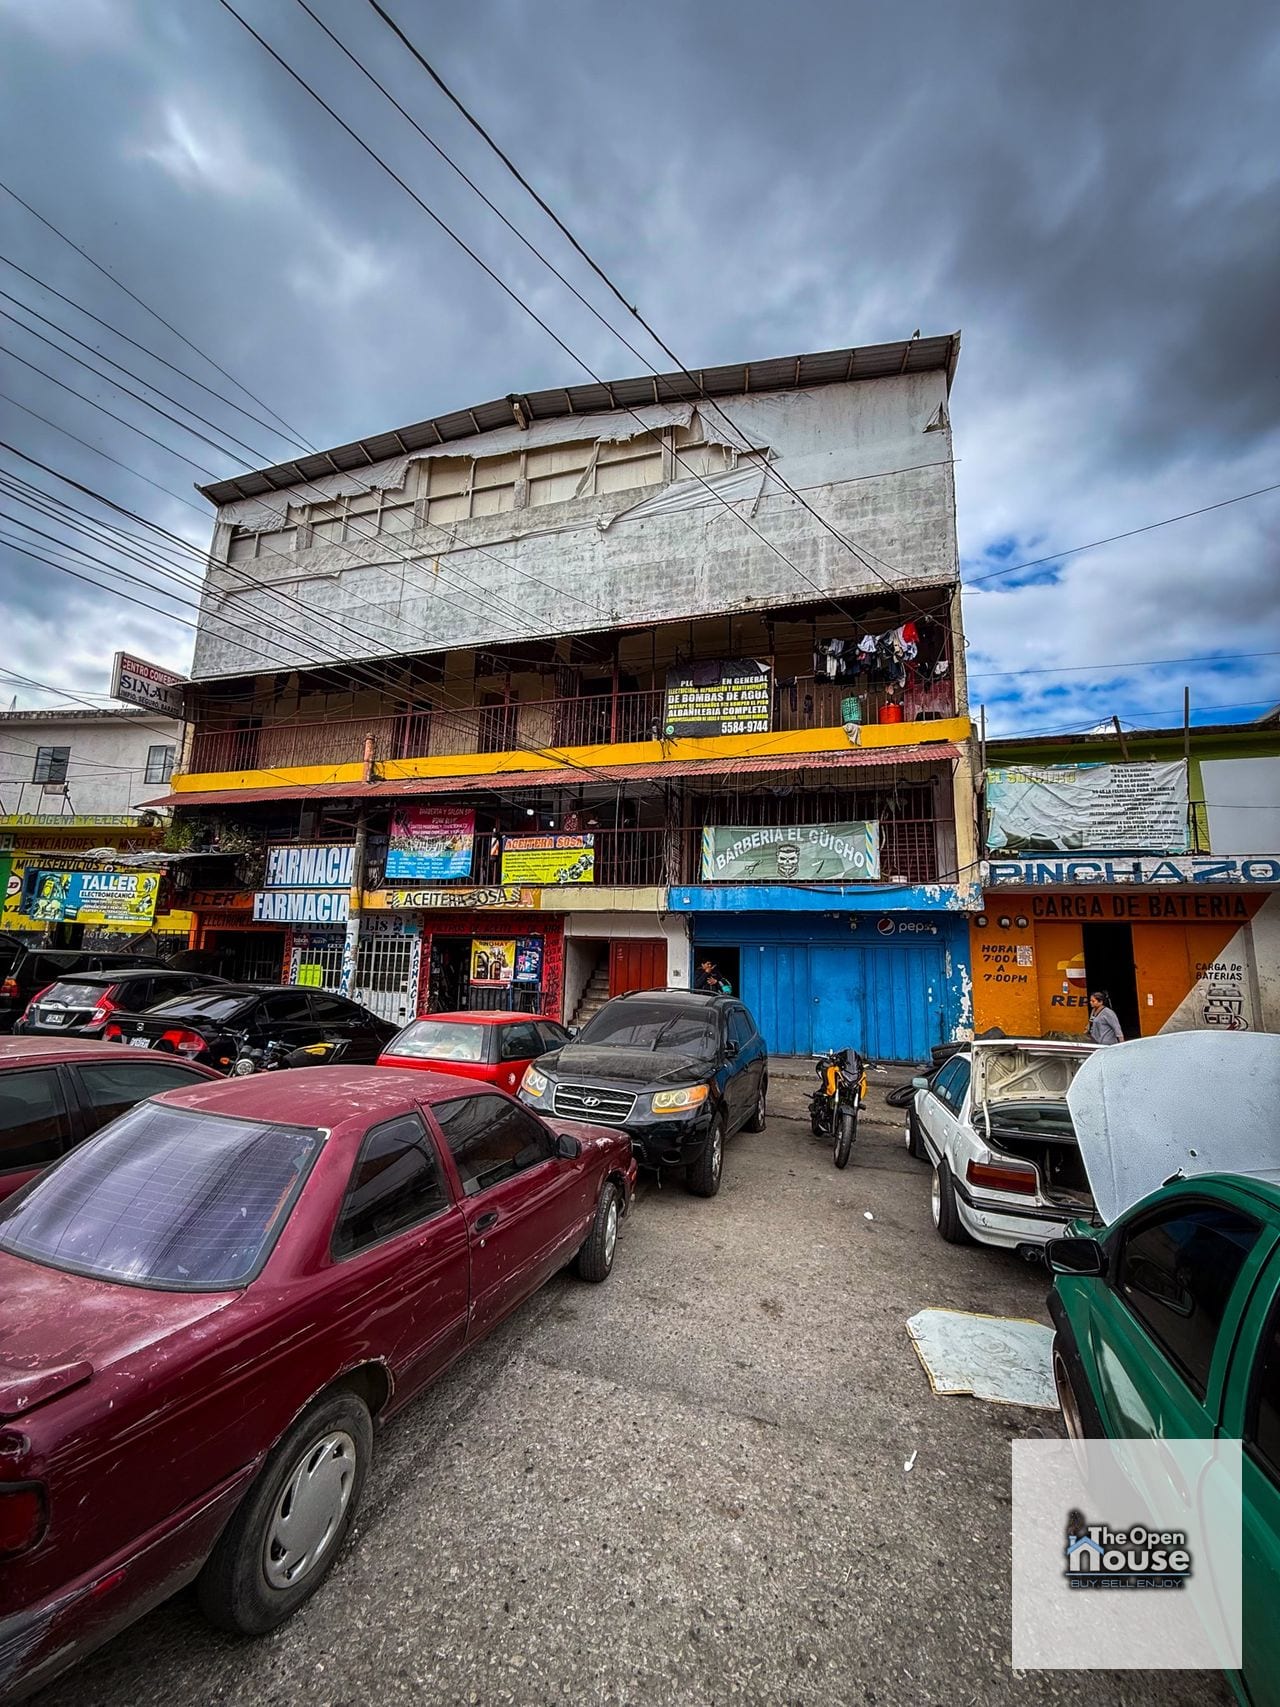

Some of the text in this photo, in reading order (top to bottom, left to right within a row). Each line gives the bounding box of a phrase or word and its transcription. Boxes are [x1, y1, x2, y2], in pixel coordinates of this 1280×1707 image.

[122, 659, 148, 677] CENTRO
[734, 675, 768, 684] GENERAL
[121, 674, 169, 702] SINAI
[668, 690, 769, 704] DE BOMBAS DE AGUA
[722, 705, 768, 715] COMPLETA
[721, 720, 768, 734] 5584-9744
[15, 837, 97, 849] SILENCIADORES
[104, 837, 113, 847] Y
[504, 835, 583, 850] ACEITERA SOSA
[716, 828, 865, 870] BARBERIA EL GÜICHO
[15, 859, 101, 871] MULTISERVICIOS
[267, 847, 356, 885] FARMACIA
[988, 859, 1280, 886] PINCHAZO
[81, 874, 138, 891] TALLER
[80, 891, 136, 899] ELECTROMECANICA
[403, 892, 467, 907] ACEITERA
[253, 893, 350, 921] FARMACIA
[1032, 895, 1248, 918] CARGA DE BATERIA
[365, 915, 388, 932] Lis
[997, 964, 1005, 972] A
[1195, 963, 1227, 971] CARGA
[408, 939, 421, 1019] FARMACIA
[1196, 972, 1243, 981] BATERIAS
